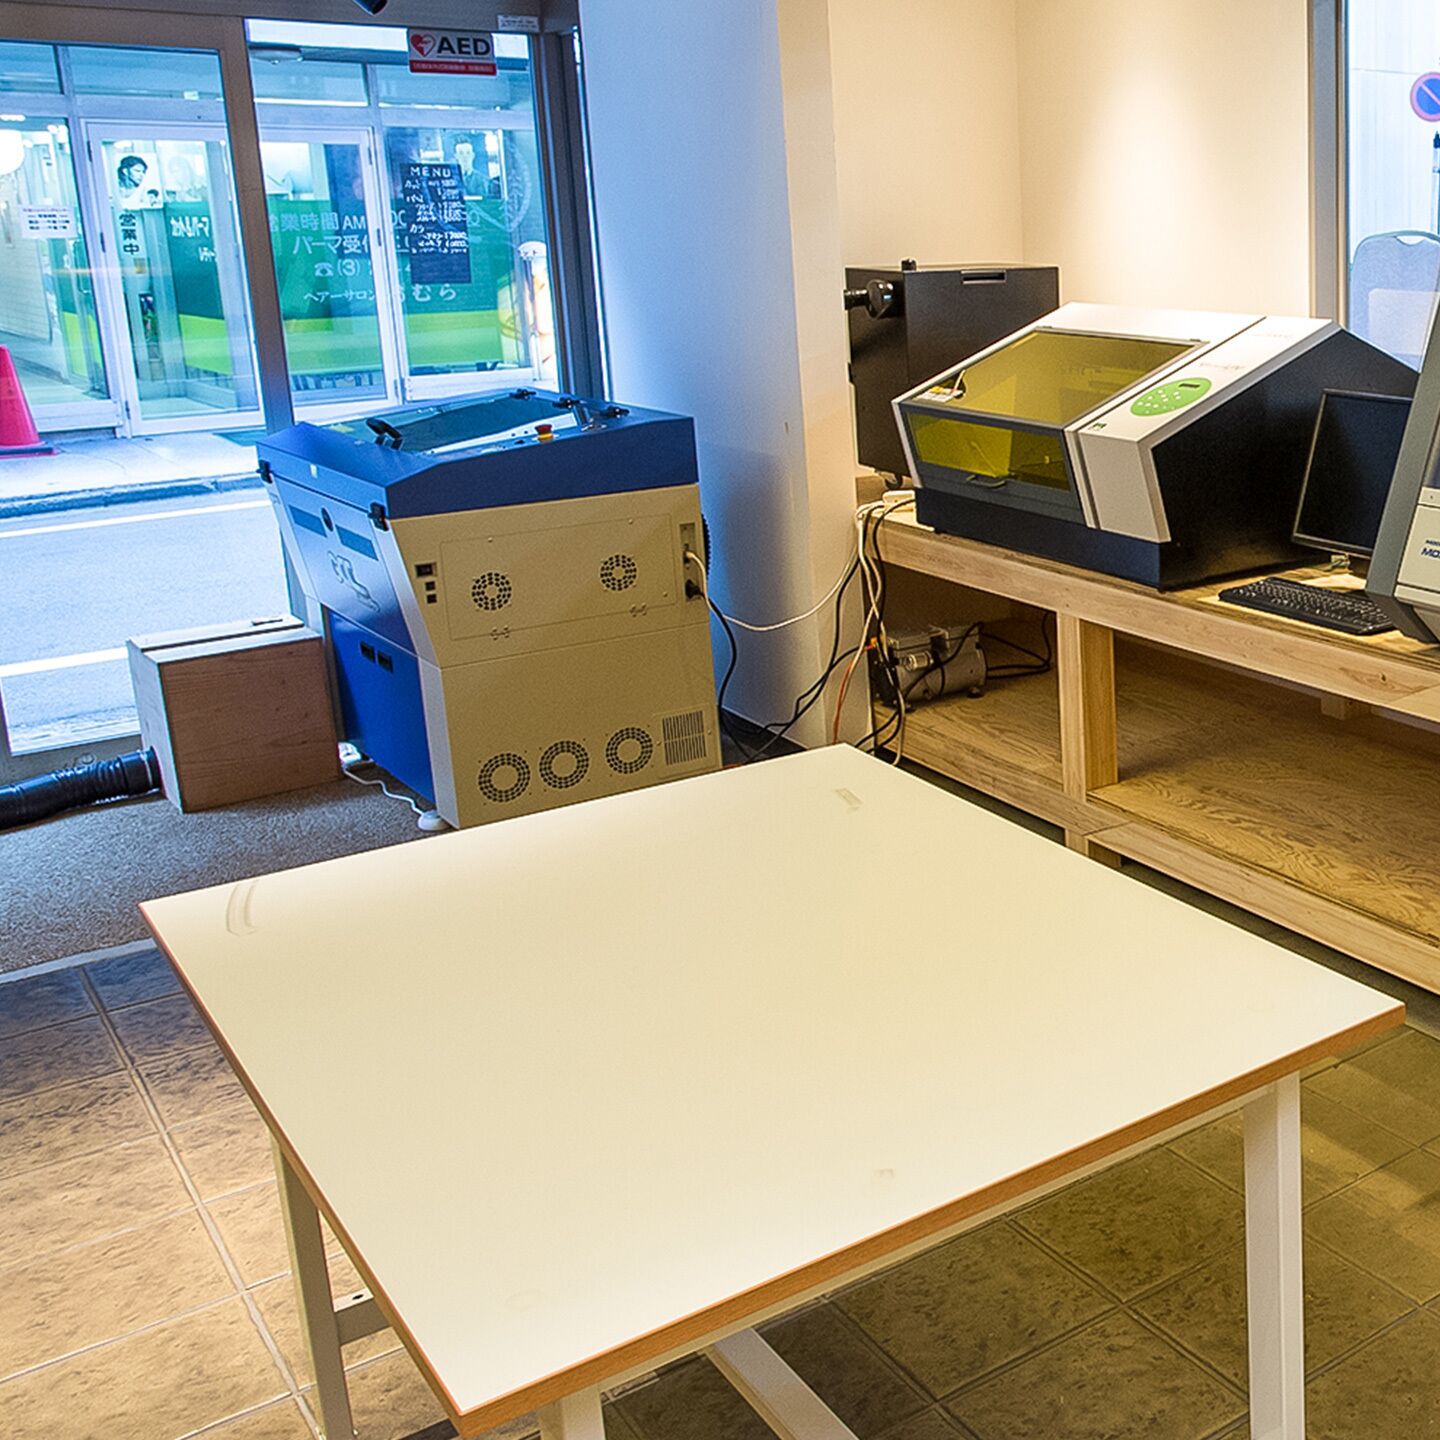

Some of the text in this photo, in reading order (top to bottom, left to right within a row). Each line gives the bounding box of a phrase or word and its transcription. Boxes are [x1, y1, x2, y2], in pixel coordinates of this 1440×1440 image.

[437, 36, 491, 56] AED
[410, 166, 452, 178] MENU
[119, 212, 140, 255] 営業中
